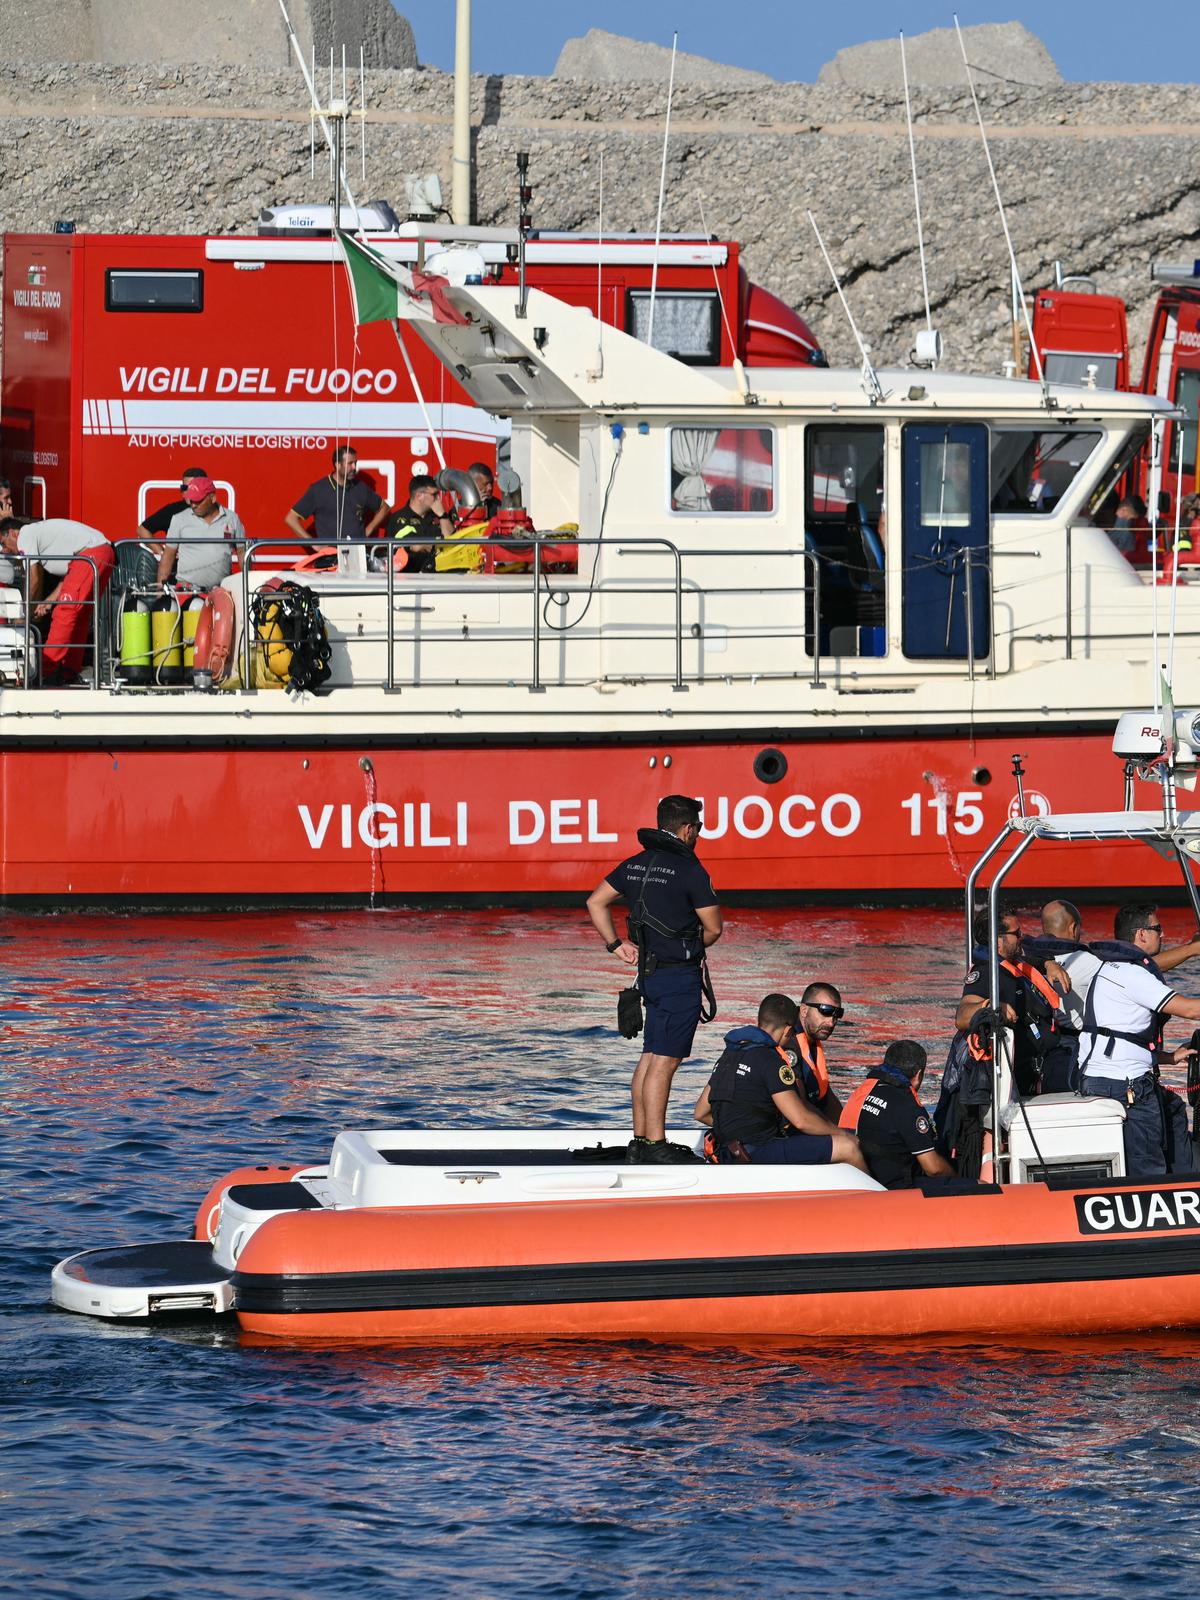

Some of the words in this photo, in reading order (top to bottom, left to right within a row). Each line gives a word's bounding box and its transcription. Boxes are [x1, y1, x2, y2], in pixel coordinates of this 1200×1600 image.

[287, 216, 315, 226] Telair
[13, 289, 30, 307] VIGILI
[31, 290, 40, 307] DEL
[41, 291, 61, 308] FUOCO
[119, 367, 208, 393] VIGILI
[215, 367, 276, 393] DEL
[285, 368, 397, 394] FUOCO
[128, 433, 244, 449] AUTOFURGONE
[246, 435, 328, 449] LOGISTICO
[1141, 726, 1160, 737] Ra
[298, 801, 467, 849] VIGILI
[508, 799, 618, 845] DEL
[696, 793, 861, 840] UOCO
[901, 792, 984, 837] 115
